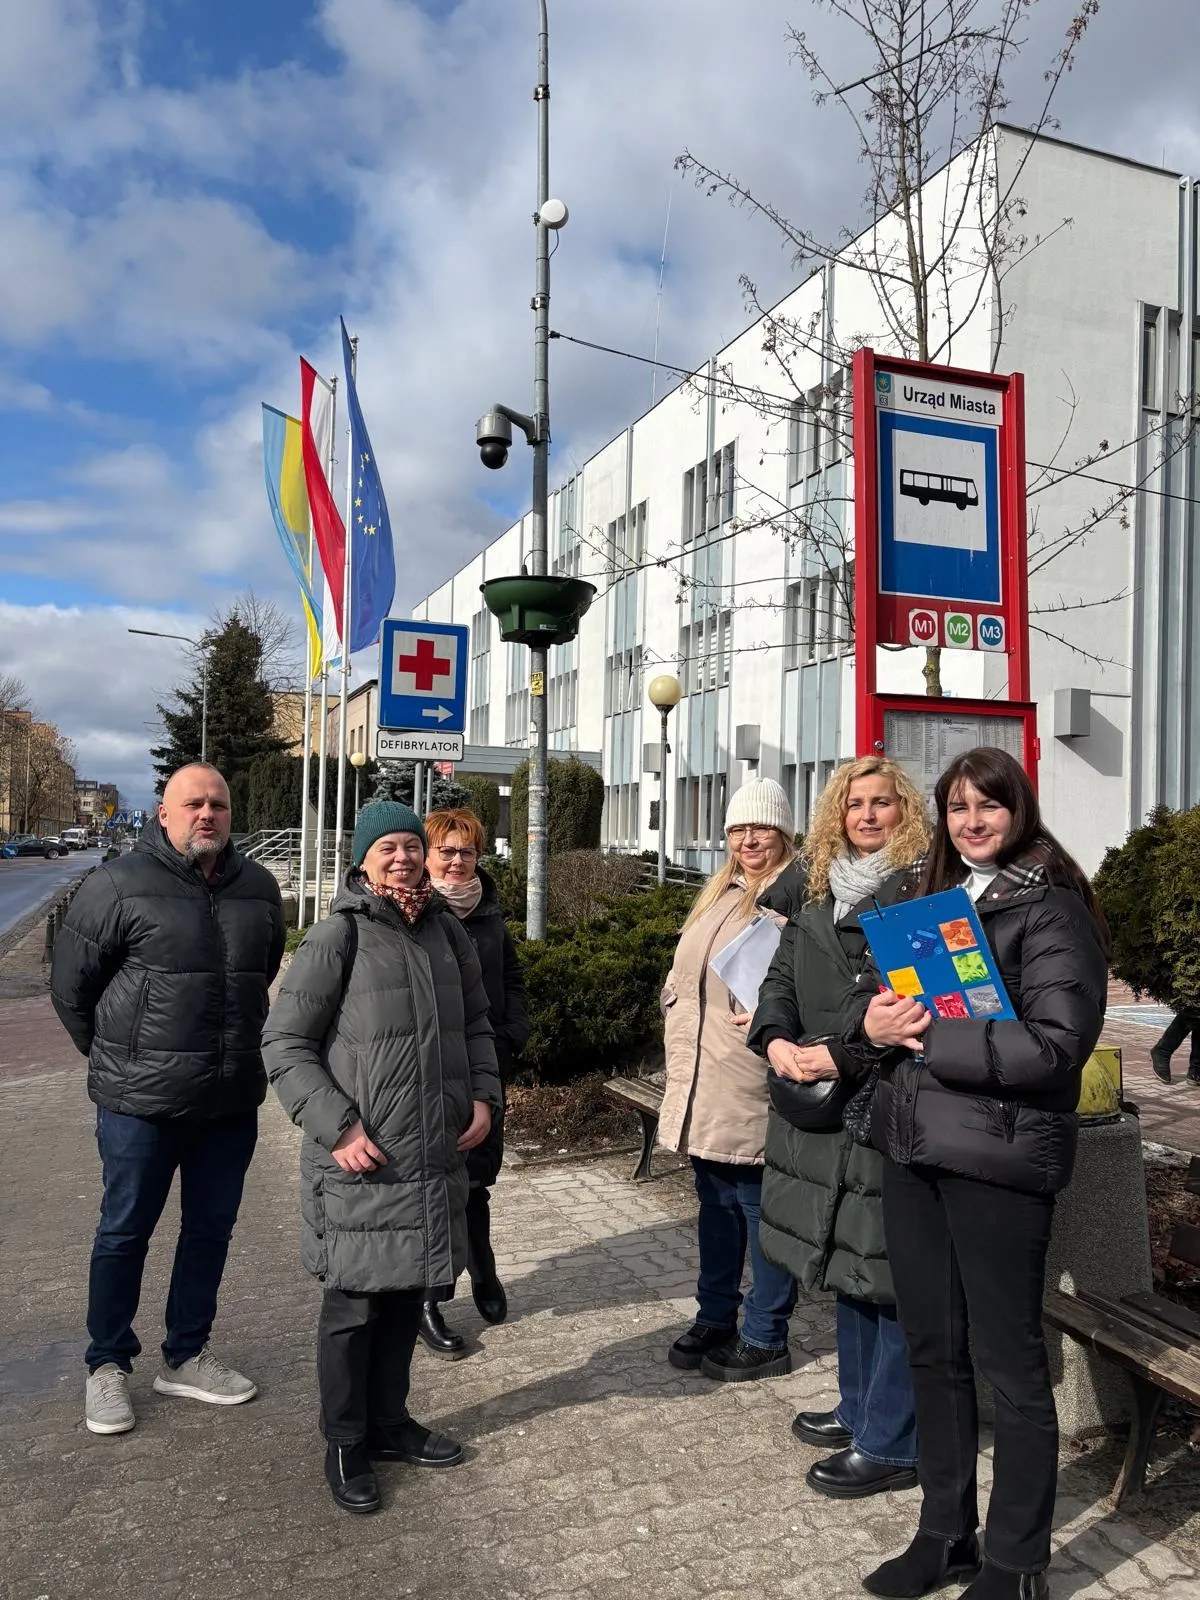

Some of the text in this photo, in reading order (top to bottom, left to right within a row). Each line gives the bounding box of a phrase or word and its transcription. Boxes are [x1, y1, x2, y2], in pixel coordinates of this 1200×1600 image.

[903, 385, 996, 415] Urząd Miasta
[914, 619, 1001, 639] M1 M2 M3
[380, 740, 459, 752] DEFIBRYLATOR
